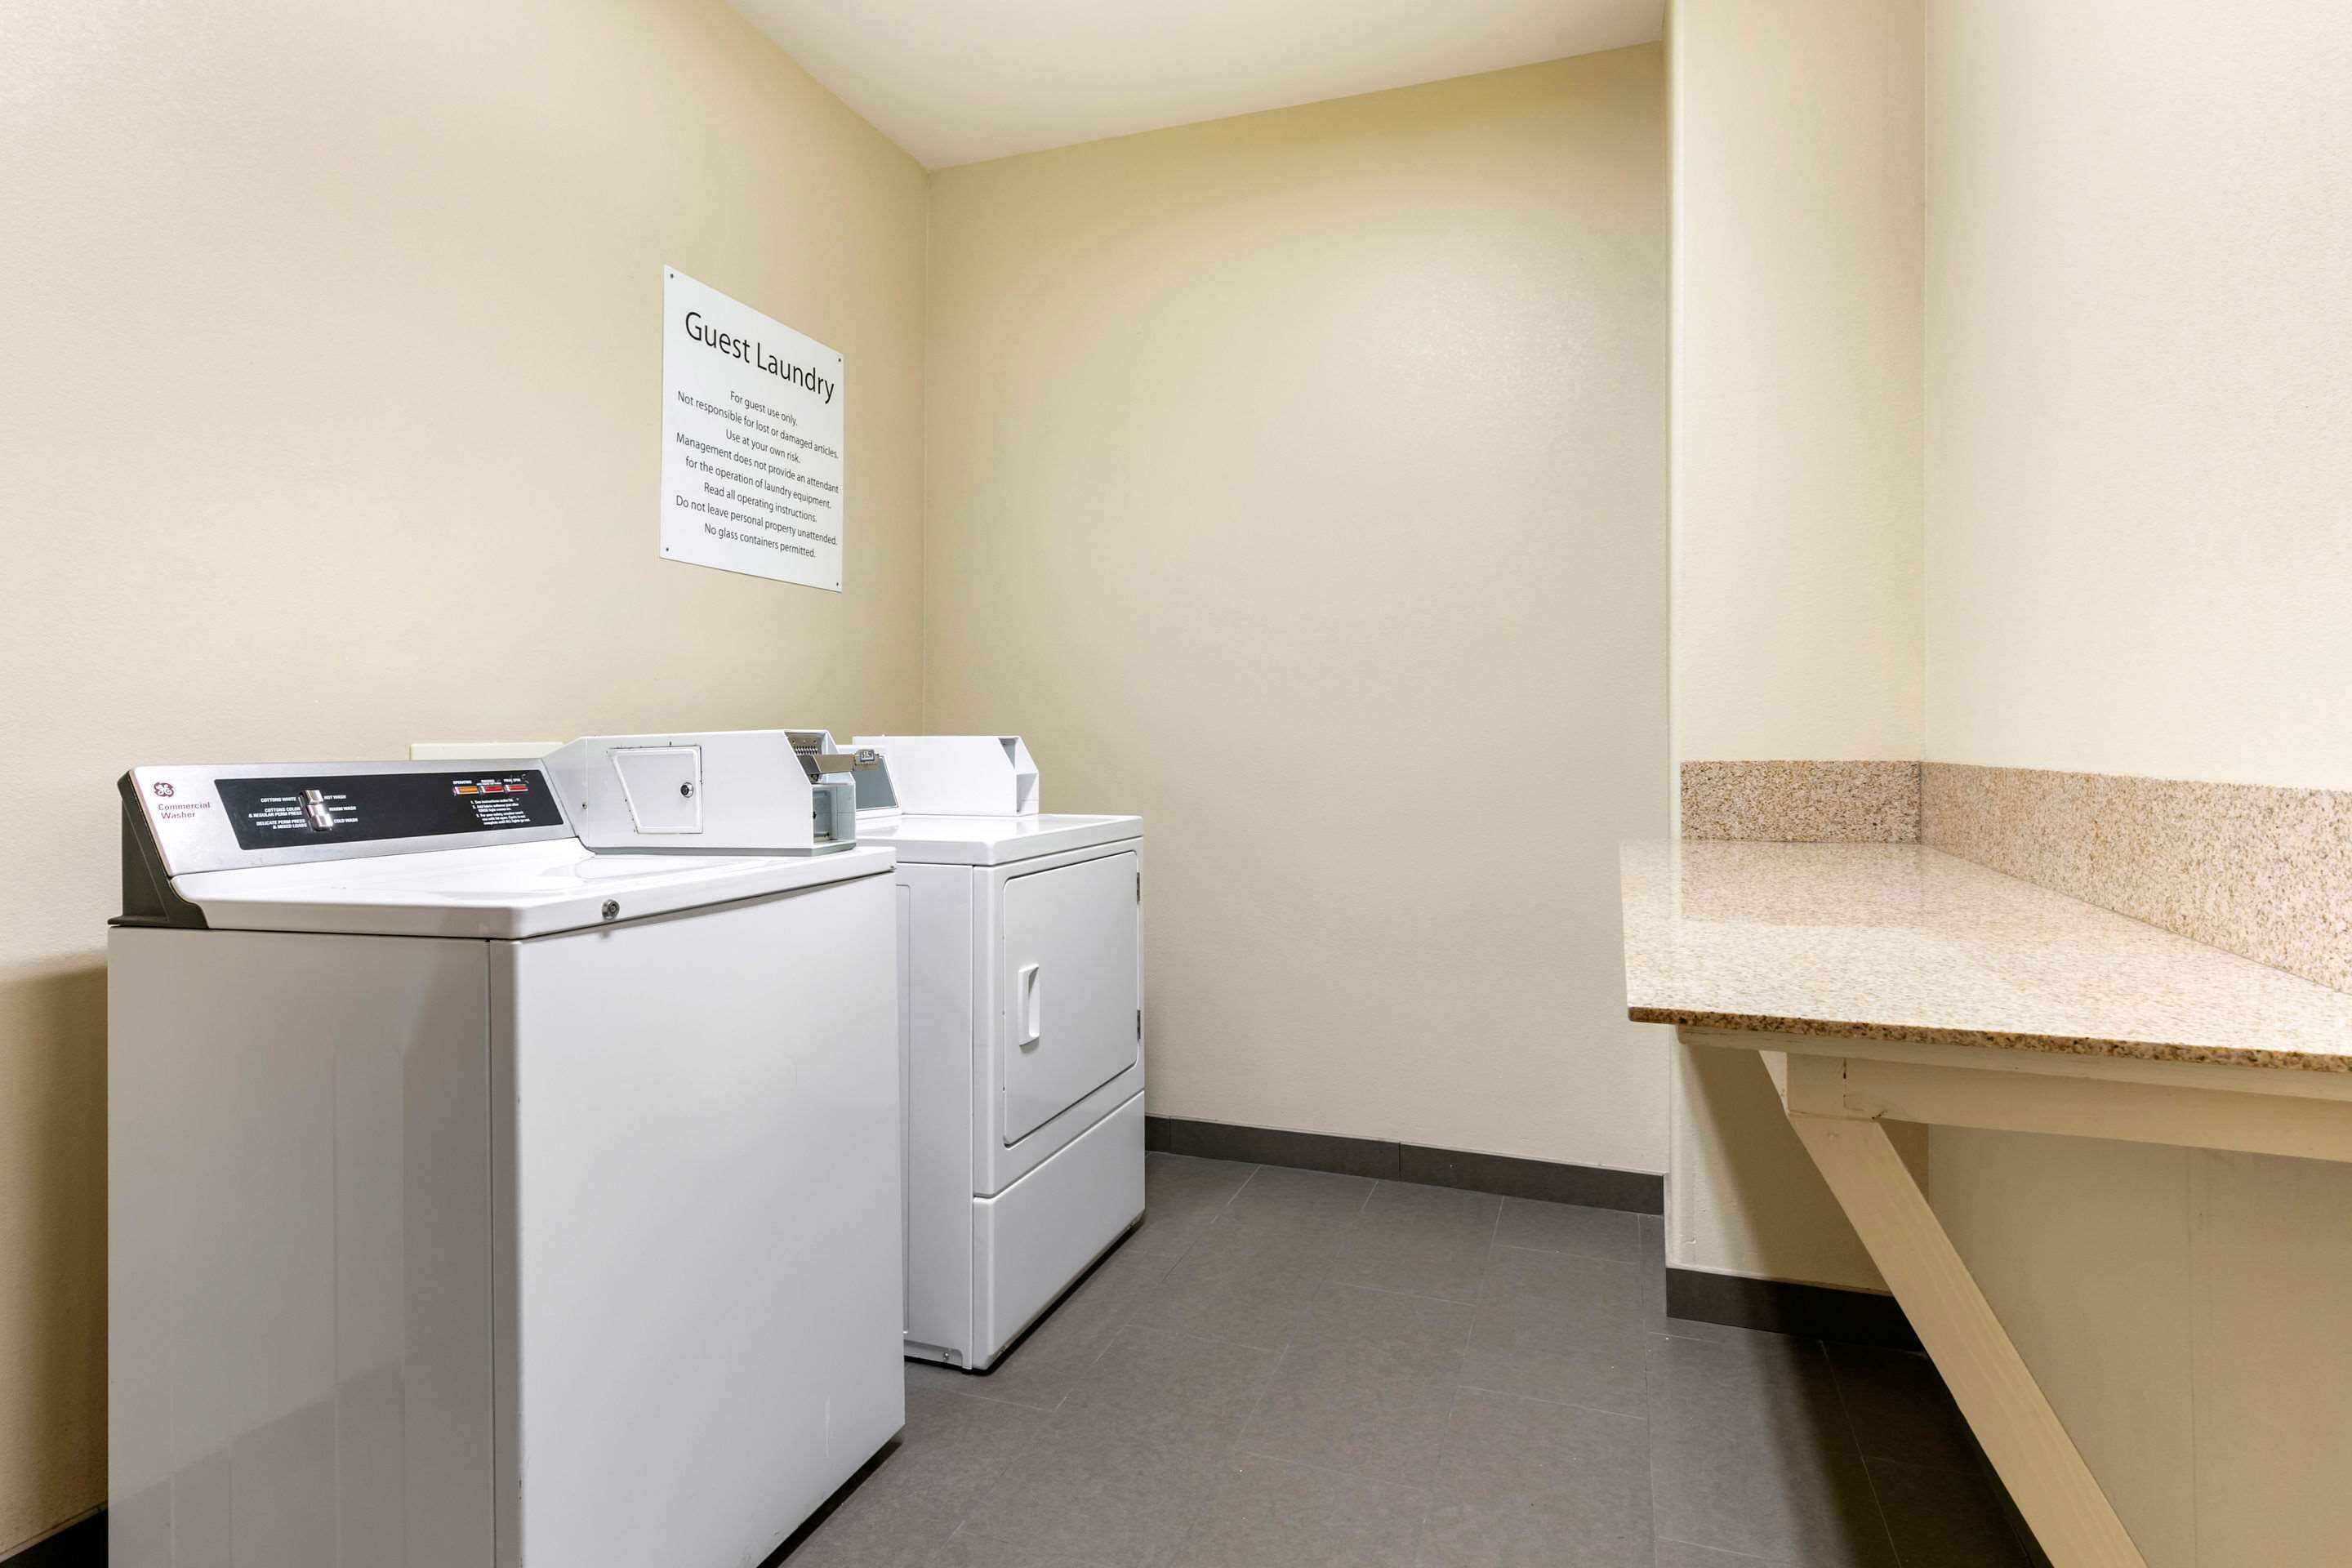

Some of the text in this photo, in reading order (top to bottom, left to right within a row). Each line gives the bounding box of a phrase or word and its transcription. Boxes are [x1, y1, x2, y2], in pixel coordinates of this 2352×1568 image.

[685, 311, 835, 404] Guest Laundry
[678, 390, 839, 459] Not responsible for lost or damaged articles.
[730, 390, 798, 426] For guest use only.
[676, 432, 839, 493] Management does not provide an attendant
[726, 429, 801, 463] Use at your own risk.
[685, 456, 831, 509] for the operation of laundry equipment.
[704, 482, 817, 523] Read all operating instructions.
[676, 495, 838, 546] Do not leave personal property unattended.
[704, 523, 816, 558] No glass containers permitted.
[158, 801, 211, 811] Commercial
[161, 811, 195, 819] Washer
